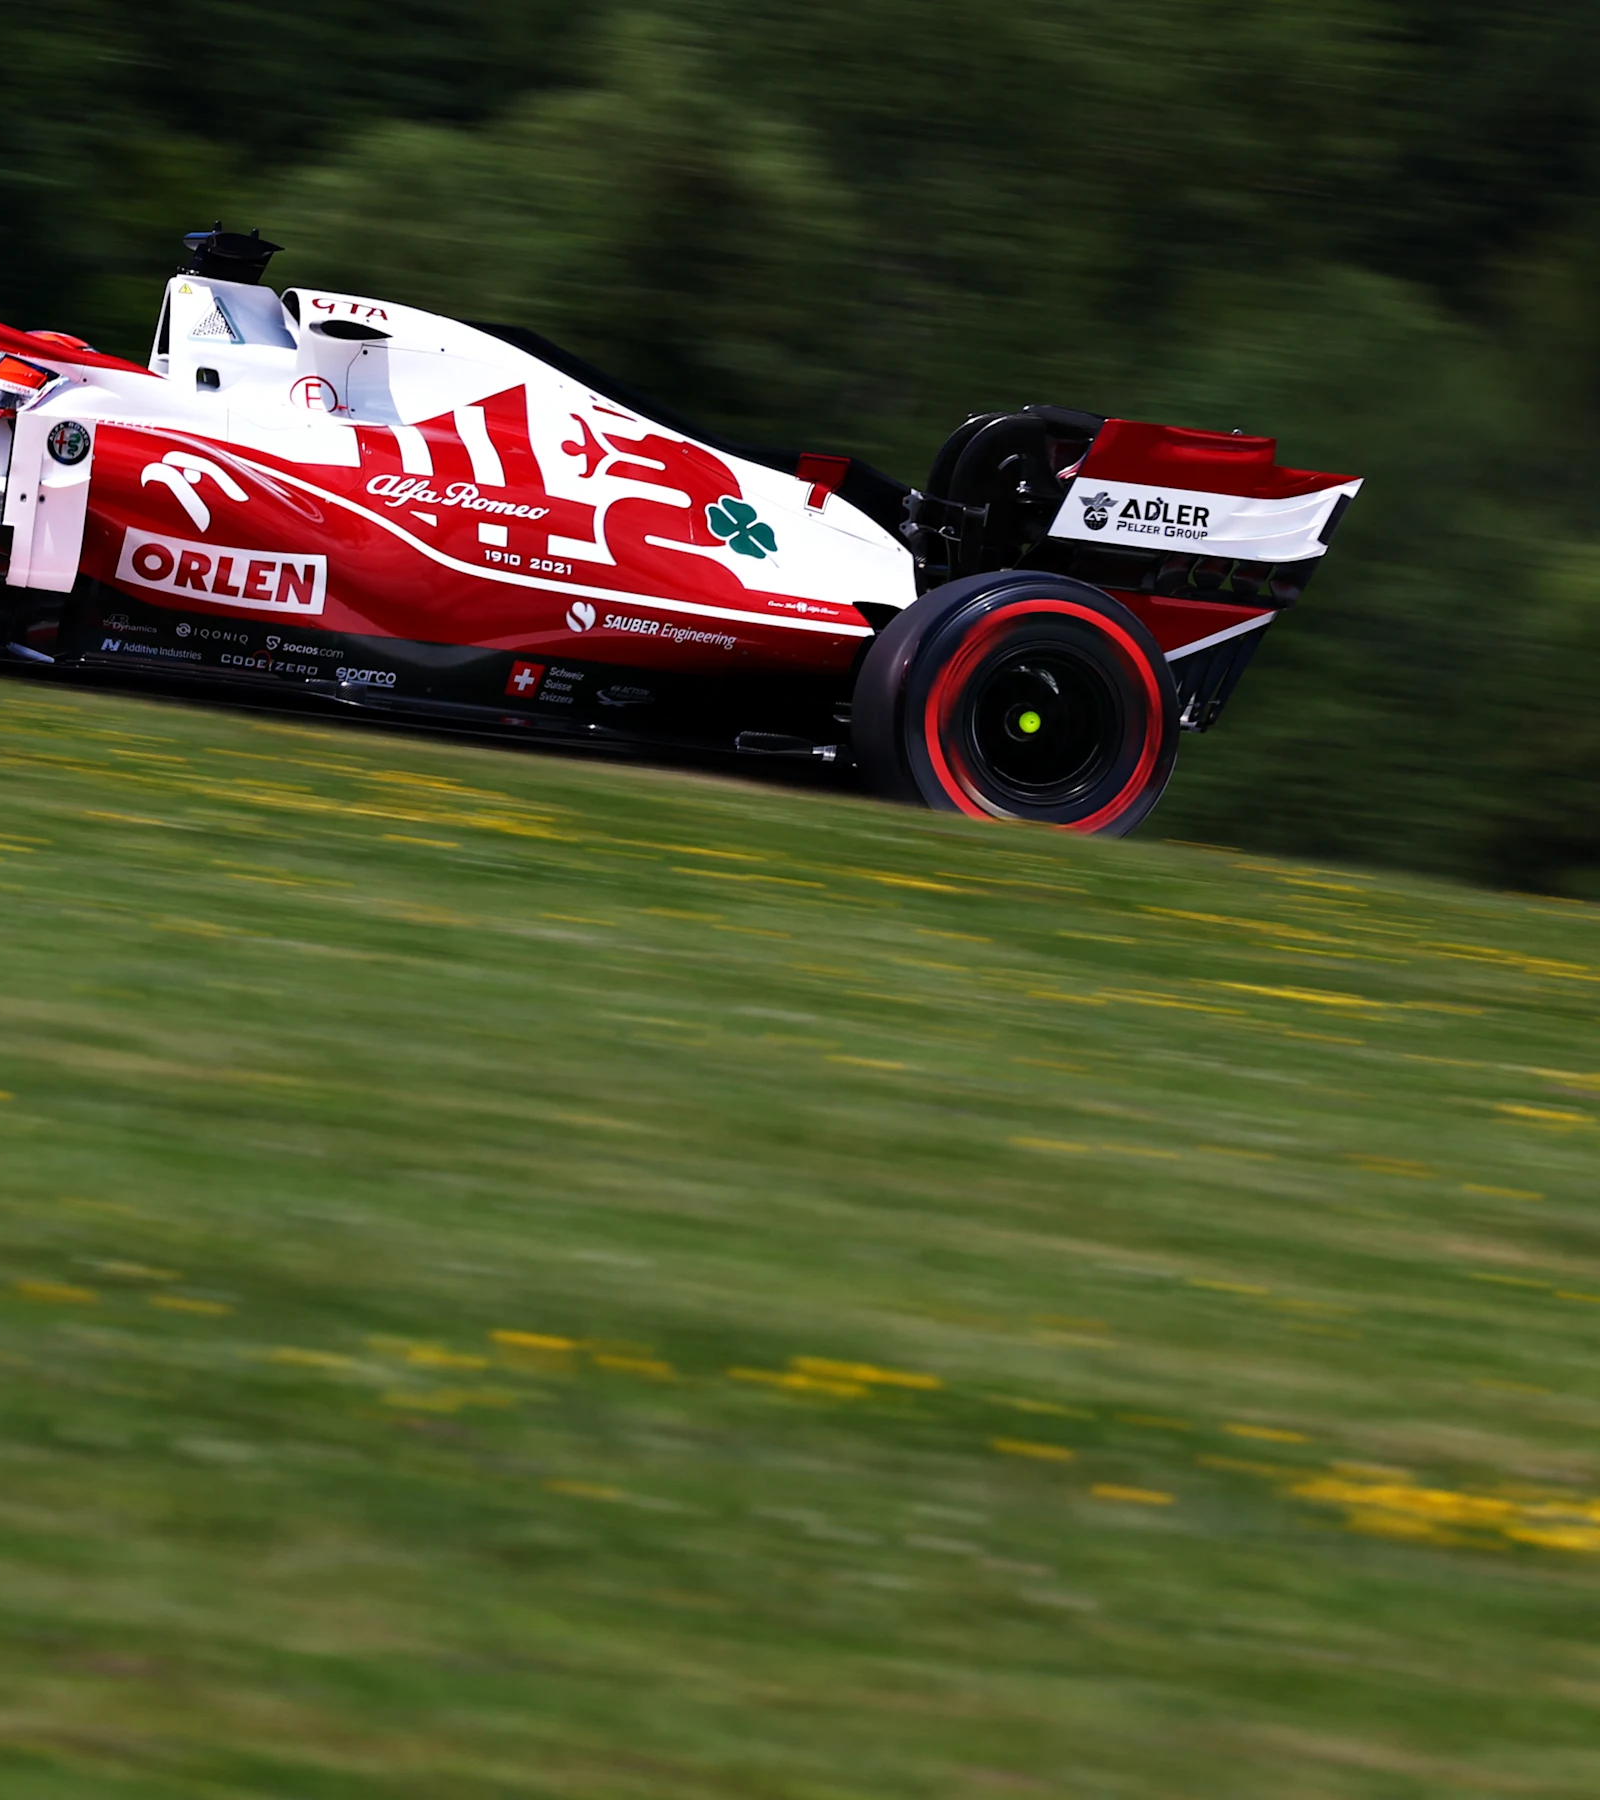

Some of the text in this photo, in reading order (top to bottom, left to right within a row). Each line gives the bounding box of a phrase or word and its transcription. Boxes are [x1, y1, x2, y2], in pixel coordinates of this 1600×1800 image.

[312, 298, 388, 321] GTA
[366, 474, 550, 520] Alfa Romeo
[1119, 498, 1210, 528] ADLER
[485, 550, 573, 575] 1910 2021
[132, 543, 315, 605] ORLEN
[113, 621, 157, 633] Dynamics
[194, 628, 249, 645] IQONIQ
[603, 614, 737, 650] SAUBER Engineering
[123, 642, 202, 660] Additive Industries
[335, 666, 396, 687] sparco
[549, 667, 585, 681] Schweiz
[544, 679, 572, 692] Suisse
[539, 691, 574, 704] Svizzera
